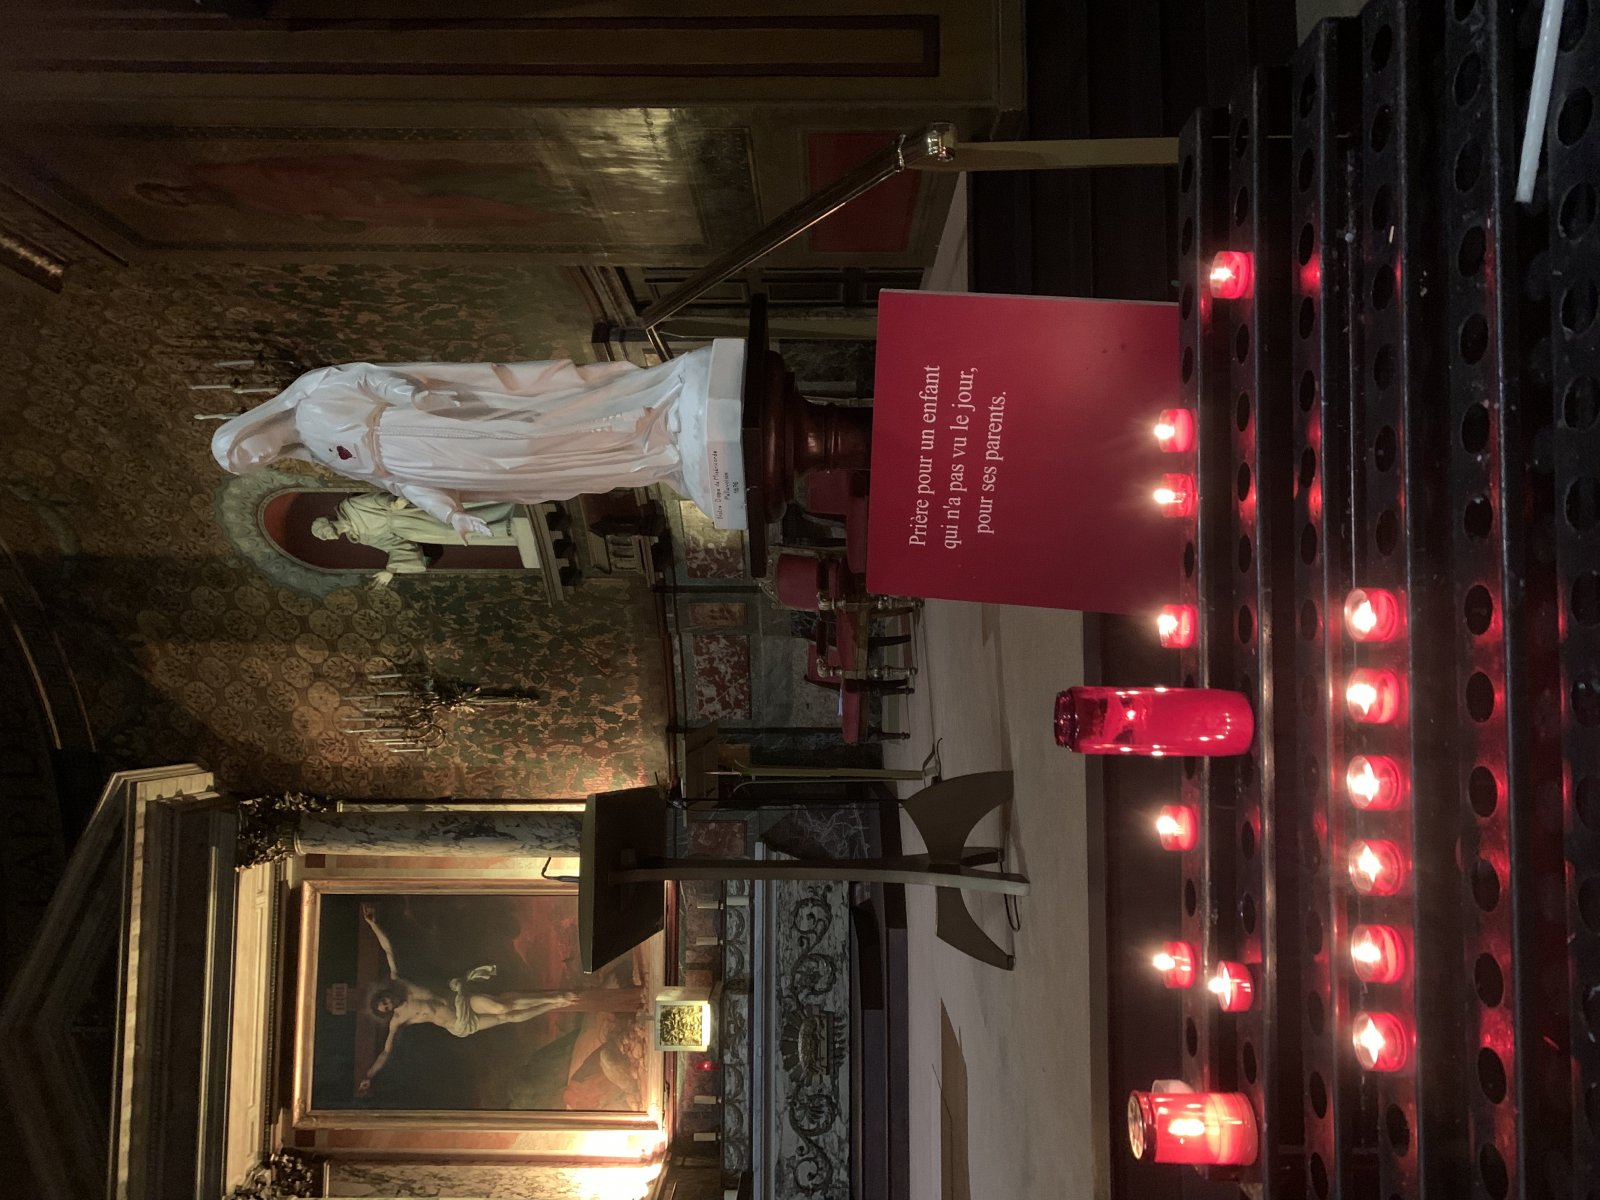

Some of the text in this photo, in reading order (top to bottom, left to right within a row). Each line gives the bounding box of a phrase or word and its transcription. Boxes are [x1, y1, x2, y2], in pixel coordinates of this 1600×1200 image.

[908, 365, 940, 546] Prière pour un enfant
[940, 367, 978, 549] qui n'a pas vu le jour,
[976, 391, 1006, 535] pour ses parents.
